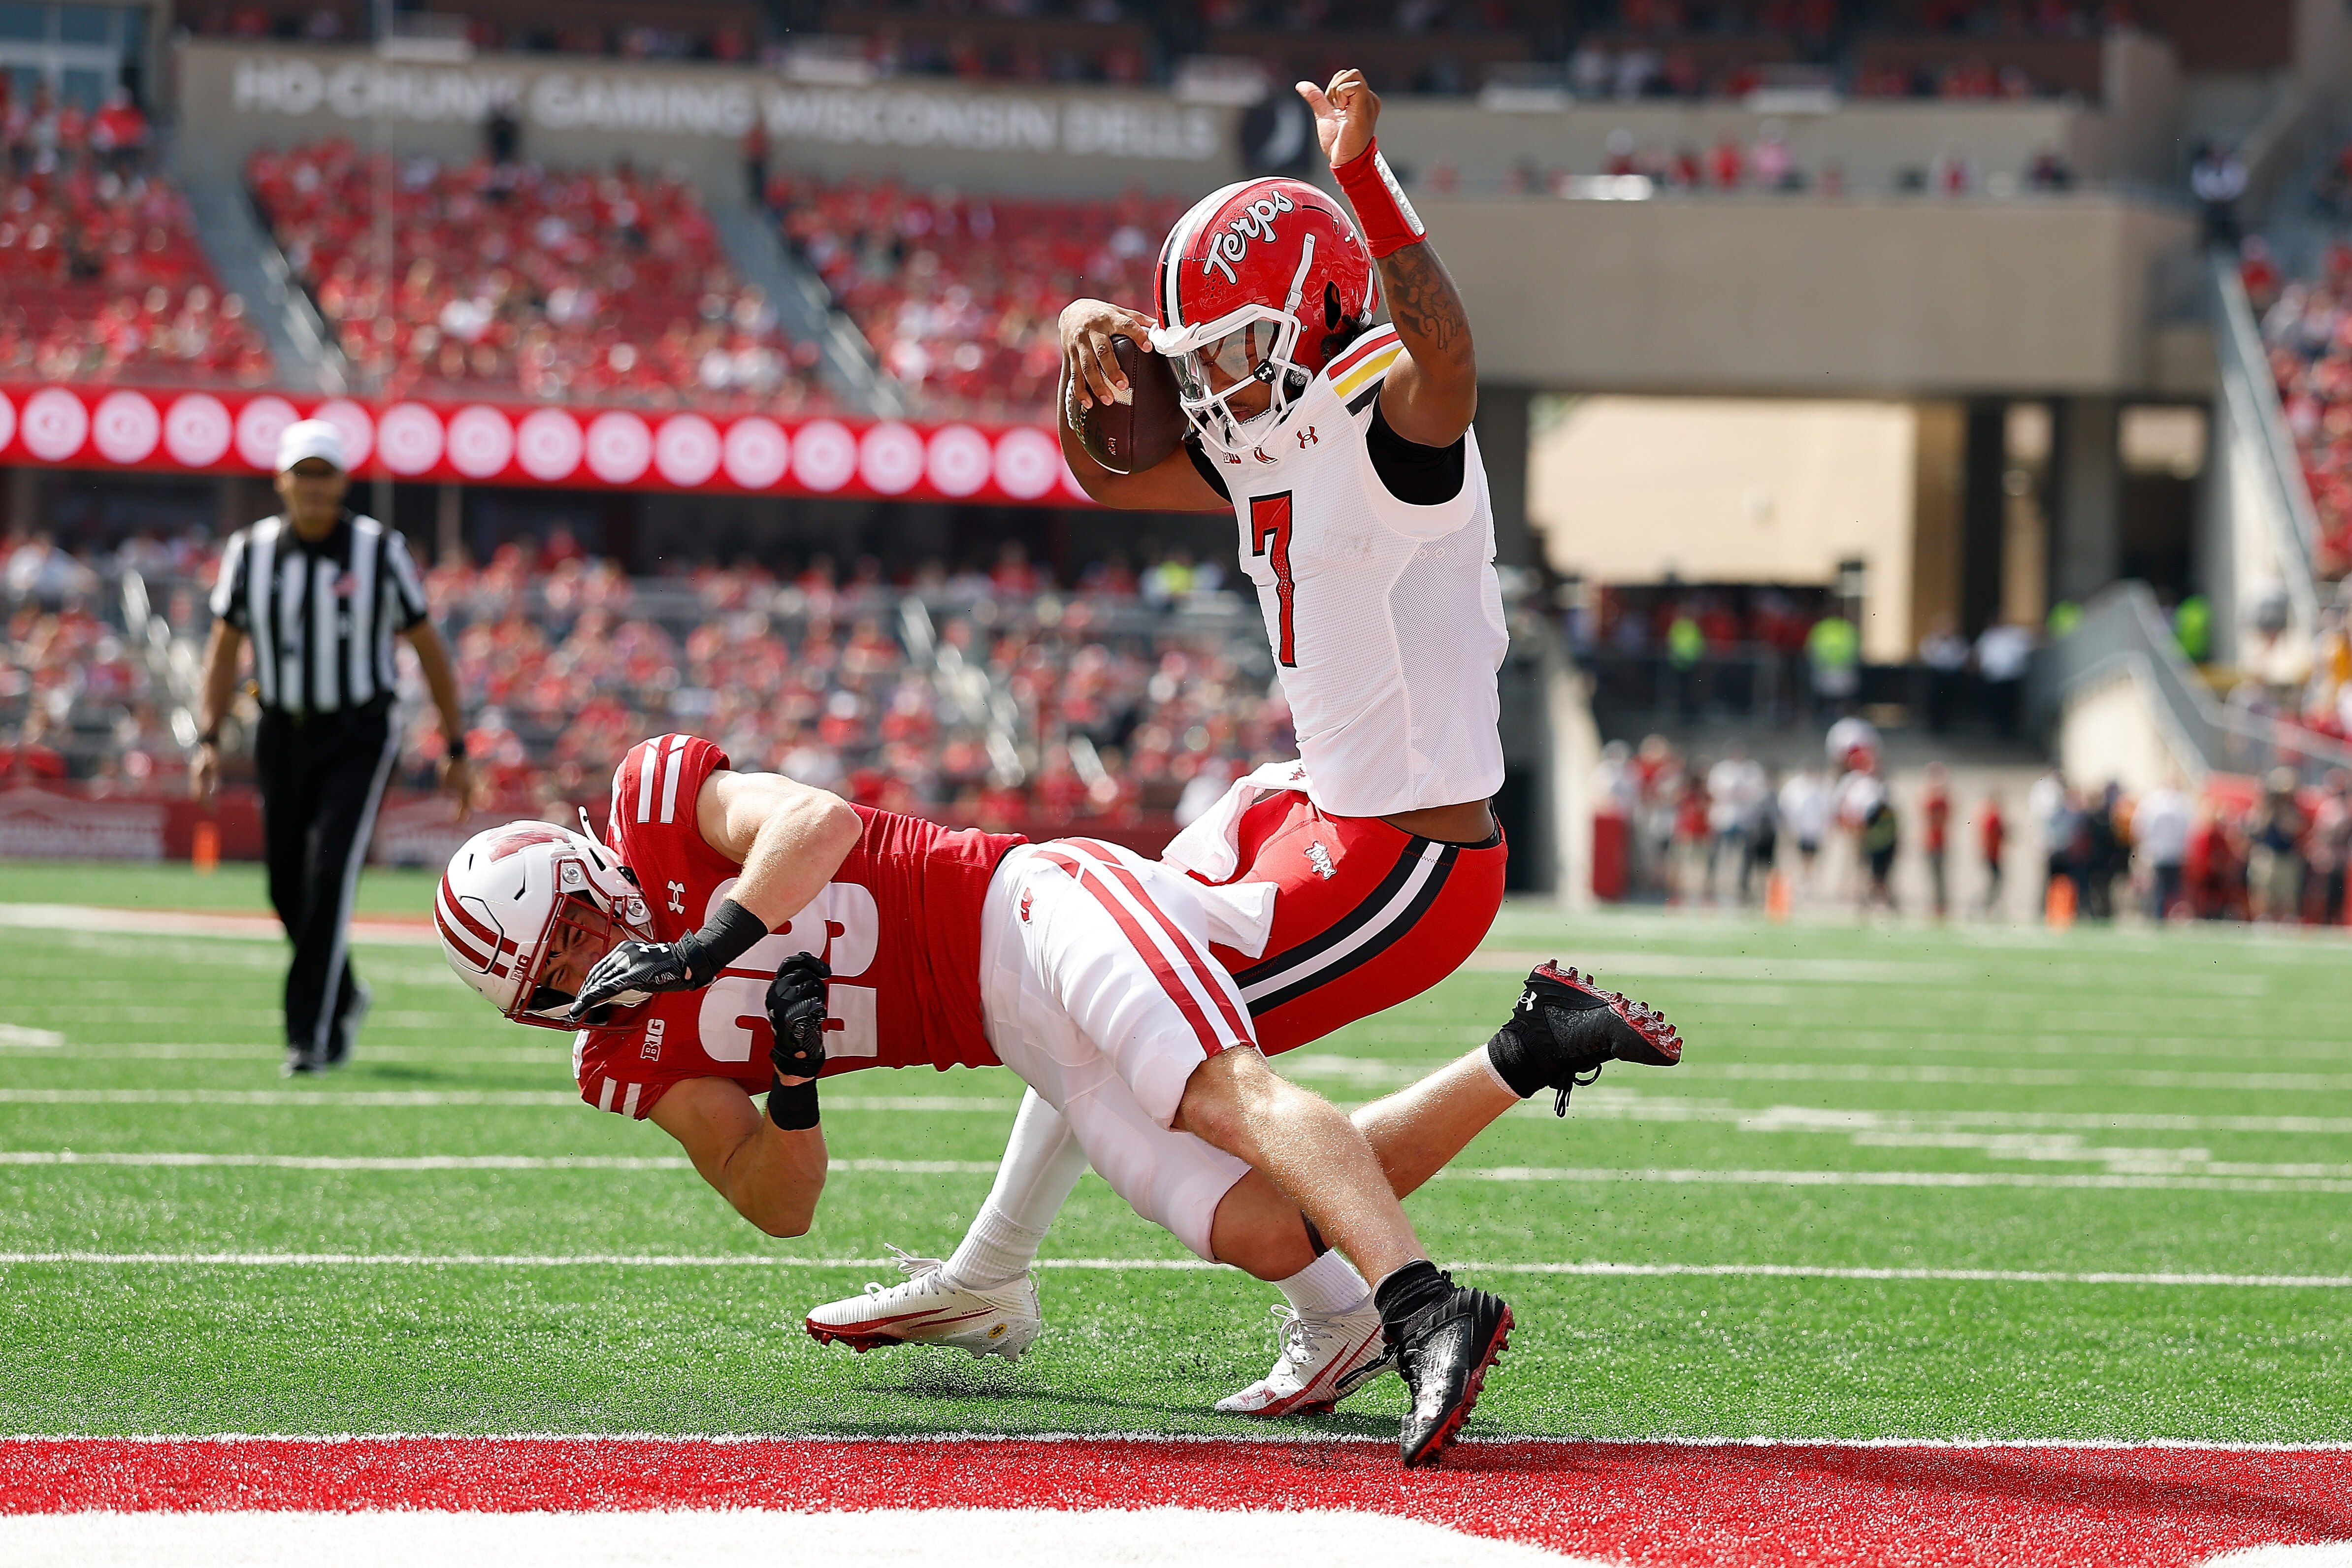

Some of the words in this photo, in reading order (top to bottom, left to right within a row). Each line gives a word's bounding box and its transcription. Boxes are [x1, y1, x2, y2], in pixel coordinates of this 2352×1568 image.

[530, 73, 755, 138] GAMING
[763, 90, 1057, 153] WISCONSIN
[1063, 102, 1219, 162] DELLS
[1203, 190, 1295, 284] Terps
[1249, 490, 1298, 668] 7
[1304, 840, 1337, 879] Terps
